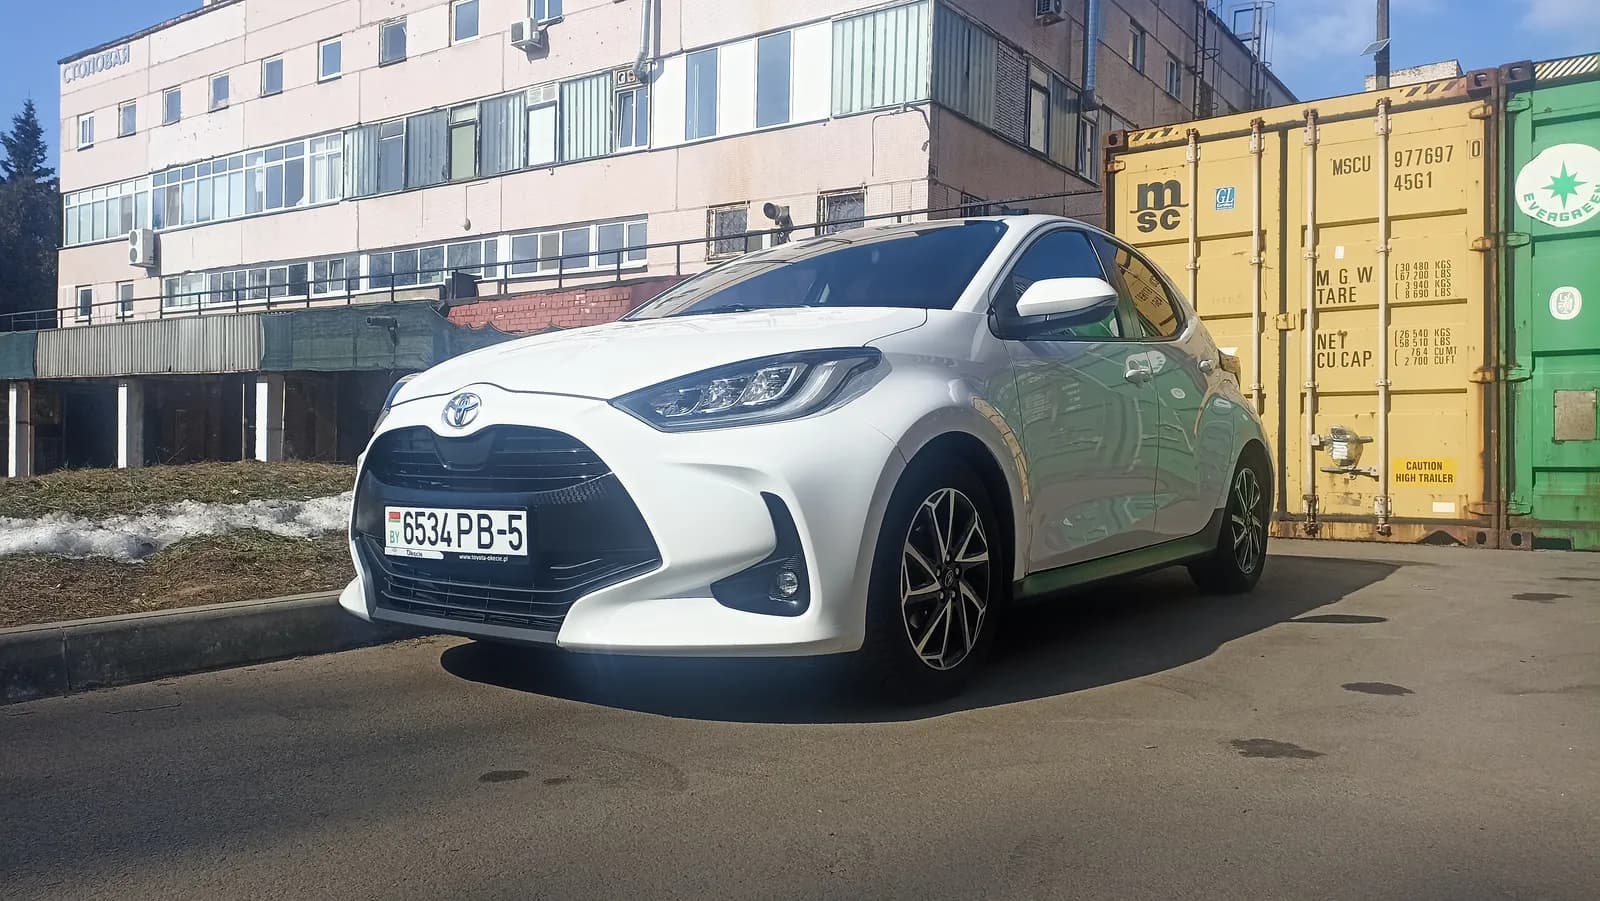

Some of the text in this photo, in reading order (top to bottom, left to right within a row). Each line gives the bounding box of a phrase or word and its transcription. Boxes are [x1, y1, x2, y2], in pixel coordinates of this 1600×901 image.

[64, 45, 130, 83] СТОЛОВАЯ
[1332, 140, 1481, 176] MSCU 977697 0
[1394, 171, 1433, 191] 45G1
[1216, 187, 1235, 204] GL
[1400, 259, 1452, 272] 30 480 KGS
[1400, 269, 1452, 280] 67 200 LBS
[1405, 278, 1452, 290] 3 940 KGS
[1317, 286, 1357, 304] TARE
[1405, 288, 1452, 299] 8 690 LBS
[1400, 328, 1451, 339] 26 540 KGS
[1317, 332, 1347, 350] NET
[1400, 337, 1451, 347] 58 510 LBS
[1405, 357, 1410, 366] 2
[1413, 356, 1428, 366] 700
[1406, 461, 1443, 471] CAUTION
[1395, 473, 1454, 483] HIGH TRAILER
[389, 530, 400, 544] BY
